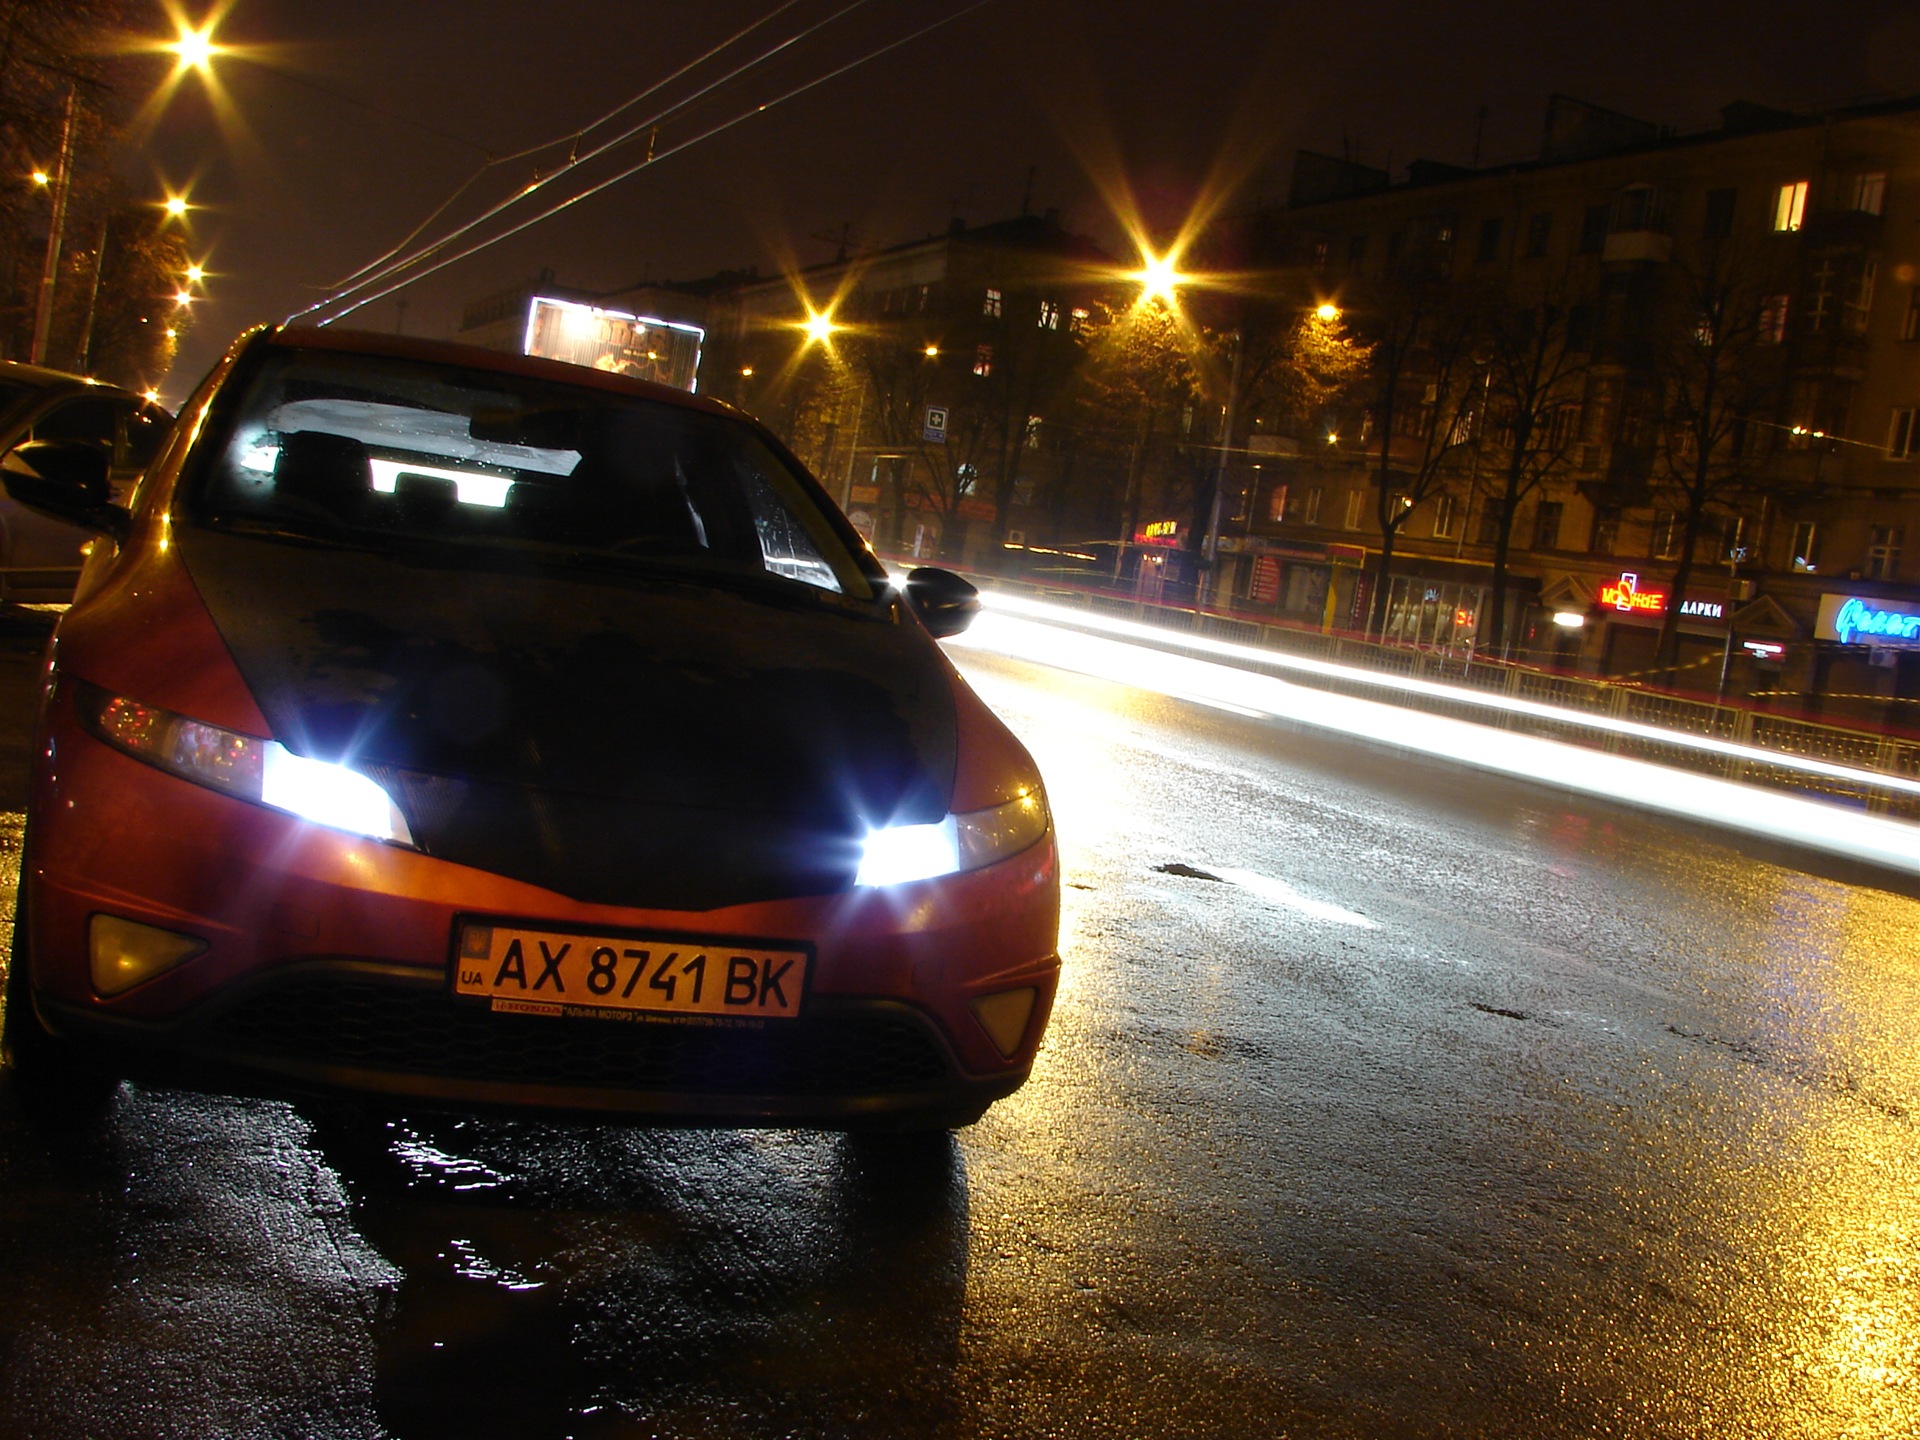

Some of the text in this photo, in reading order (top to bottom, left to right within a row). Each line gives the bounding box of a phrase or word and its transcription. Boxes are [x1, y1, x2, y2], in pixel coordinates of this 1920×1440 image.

[1602, 584, 1723, 618] МОНЫЕ ДАРКИ
[461, 970, 484, 987] UA
[493, 938, 796, 1009] AX 8741 BK
